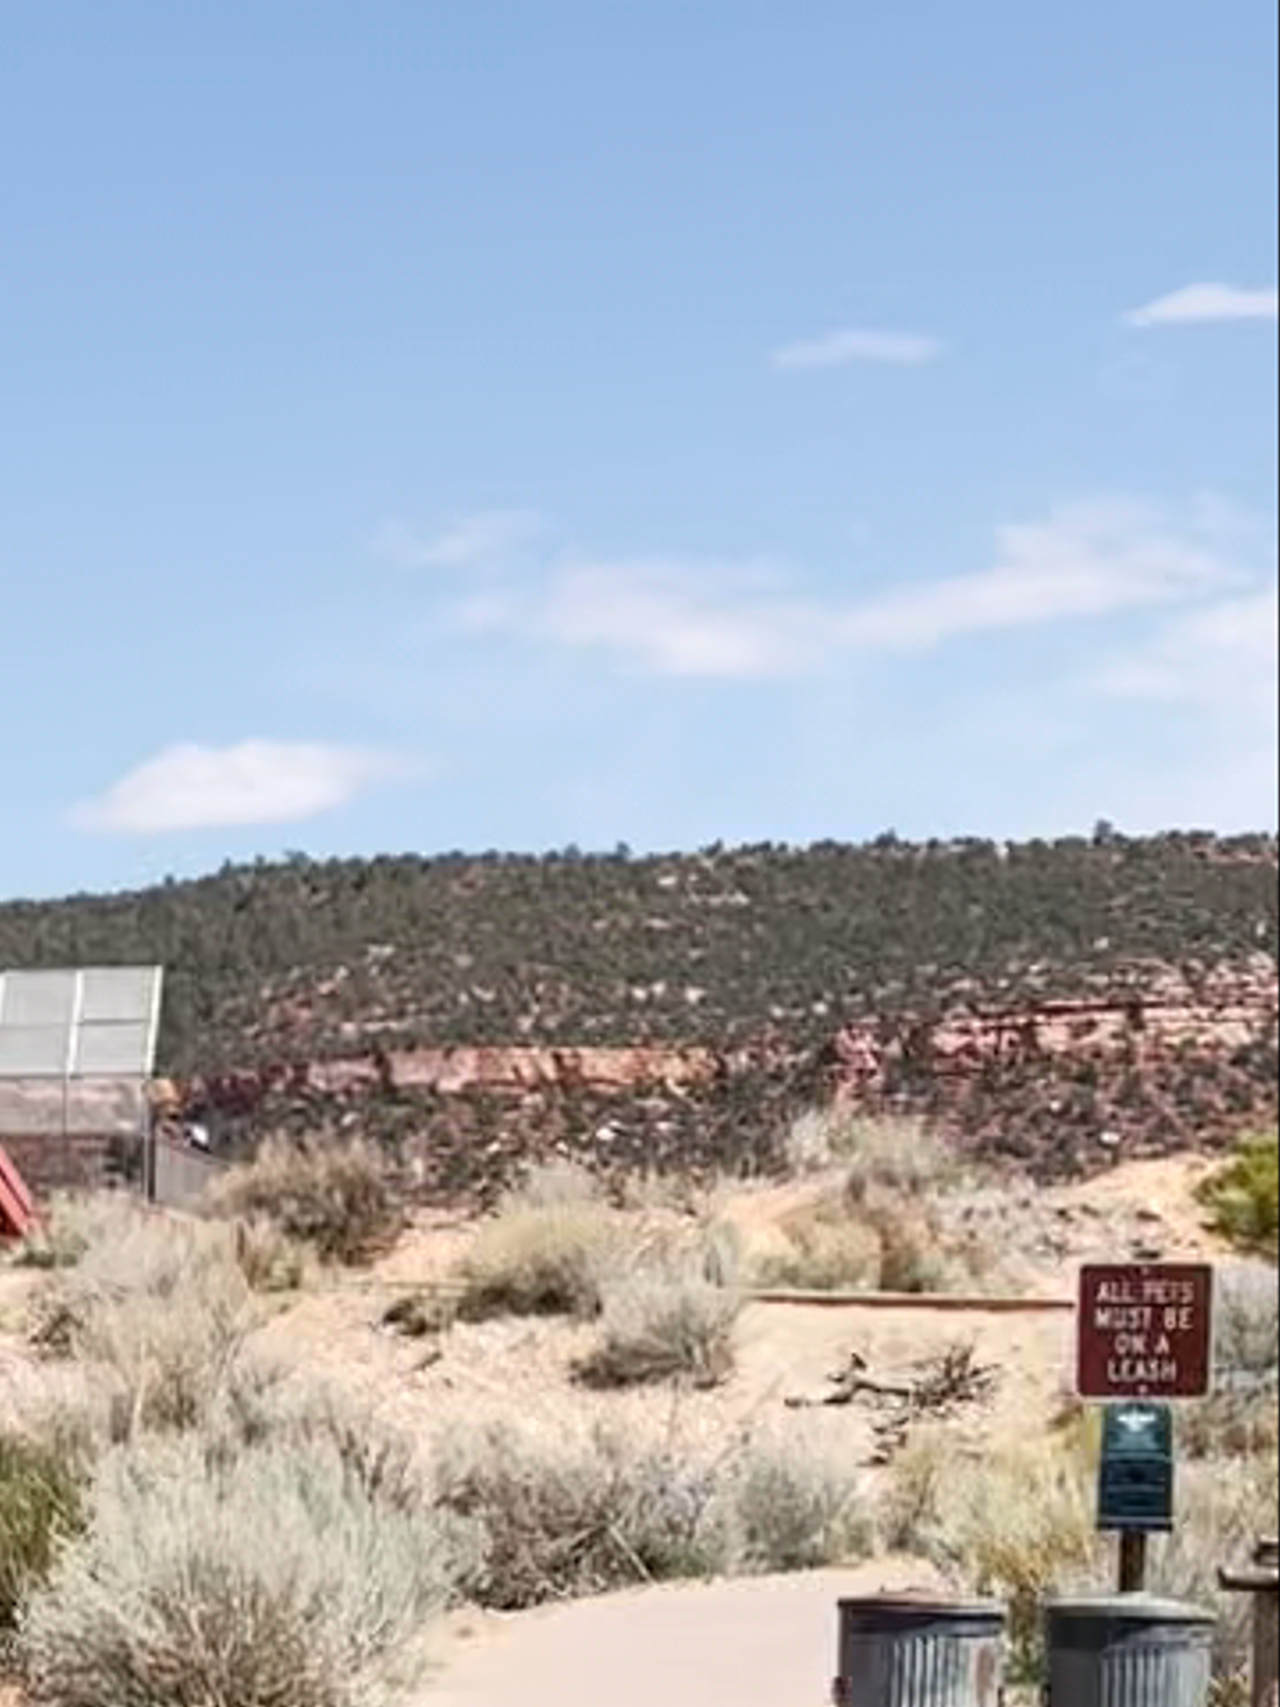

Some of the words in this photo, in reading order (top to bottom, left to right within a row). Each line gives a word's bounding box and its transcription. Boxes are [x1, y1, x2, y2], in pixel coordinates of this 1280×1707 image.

[1096, 1280, 1137, 1303] ALL
[1142, 1280, 1194, 1303] PETS
[1095, 1305, 1151, 1329] MUST
[1163, 1305, 1194, 1331] BE
[1114, 1334, 1147, 1355] ON
[1154, 1332, 1170, 1354] A
[1107, 1357, 1177, 1382] LEASH
